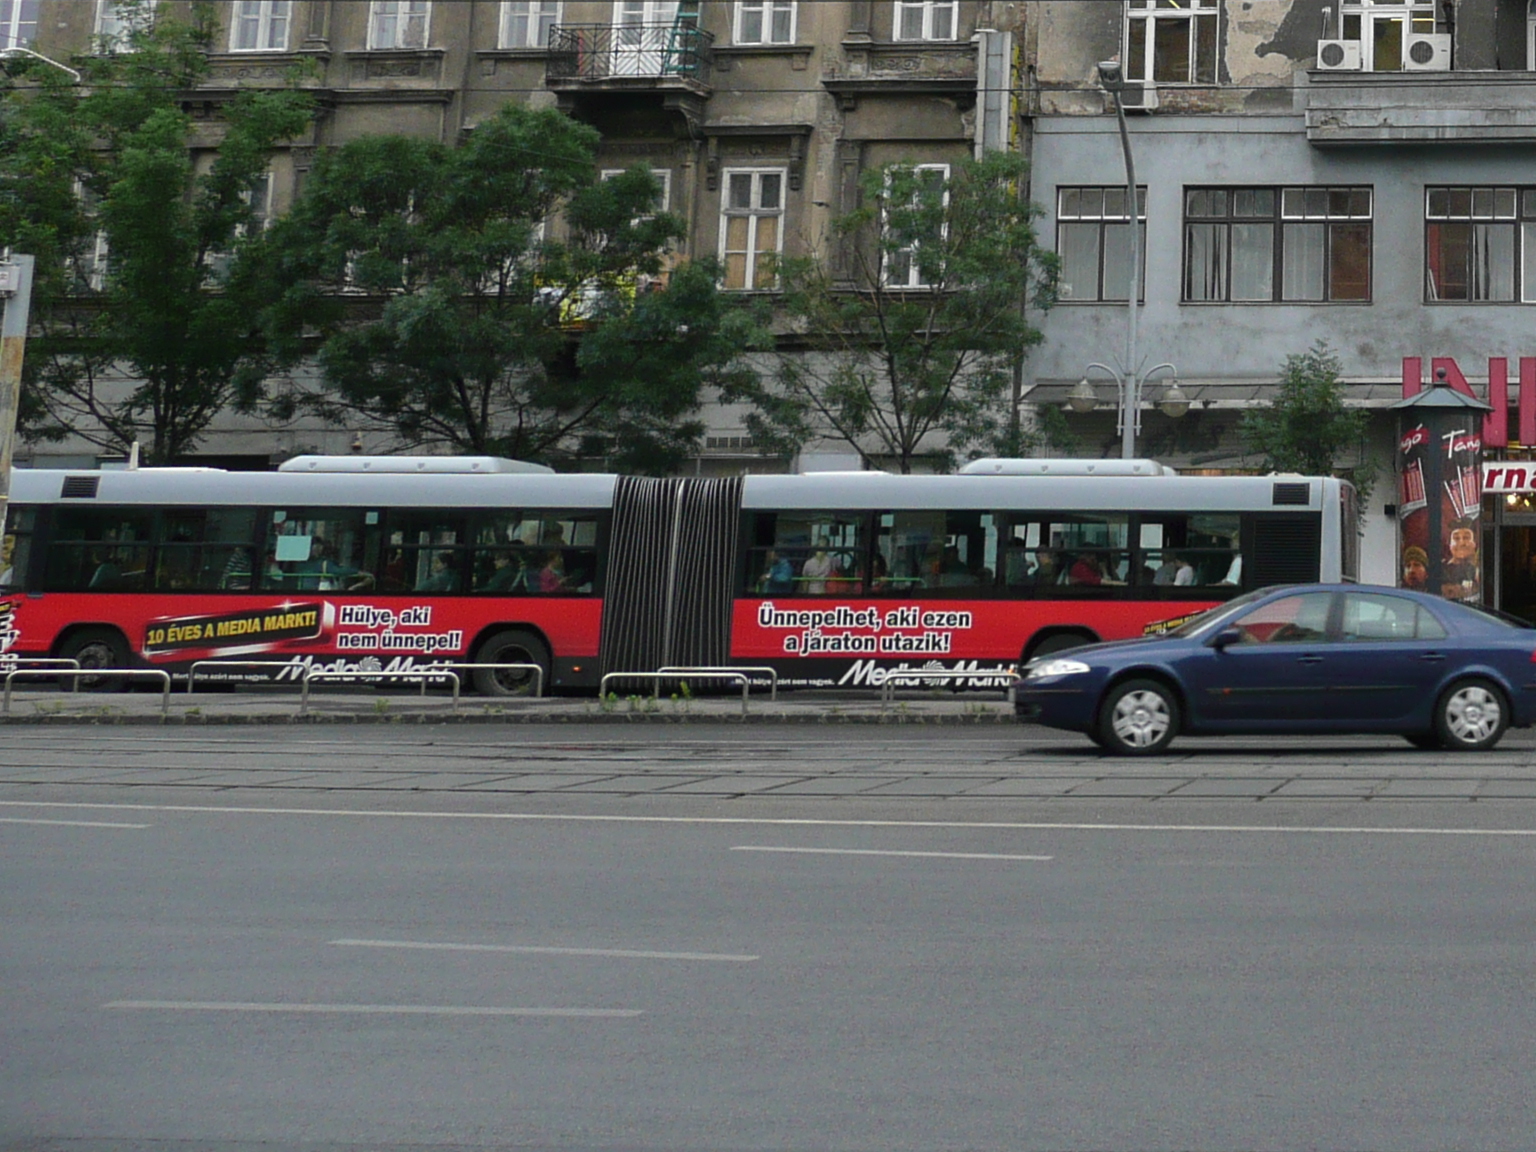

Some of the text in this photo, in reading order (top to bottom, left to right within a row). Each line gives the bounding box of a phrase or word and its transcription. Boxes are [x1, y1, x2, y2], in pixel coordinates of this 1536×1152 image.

[1442, 429, 1480, 459] Tang
[147, 610, 317, 645] 10 ÉVES A MEDIA MARKT!
[340, 605, 431, 629] Hülye, aki
[758, 602, 972, 631] Ünnepelhet, aki ezen
[338, 630, 462, 654] nem ünnepel!
[784, 631, 951, 656] a járaton utazik!
[275, 655, 450, 682] Media Makt
[838, 659, 921, 686] Media
